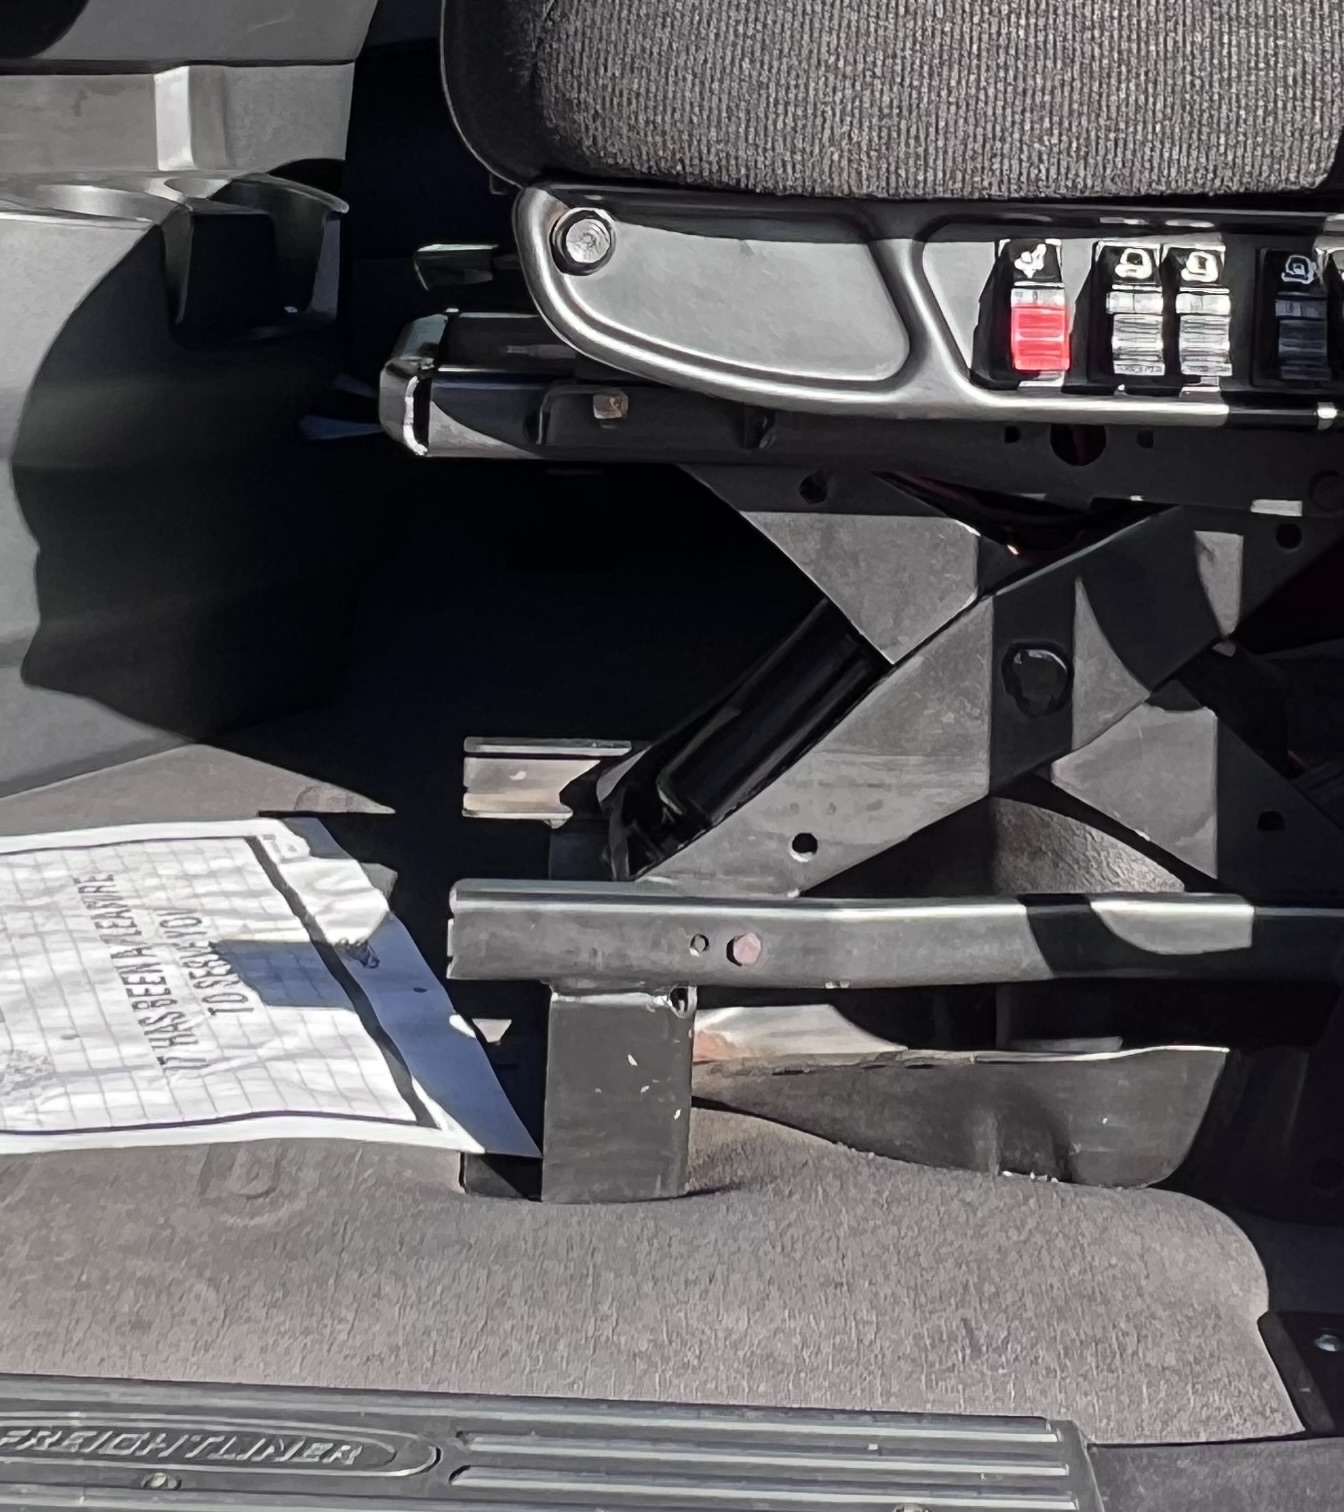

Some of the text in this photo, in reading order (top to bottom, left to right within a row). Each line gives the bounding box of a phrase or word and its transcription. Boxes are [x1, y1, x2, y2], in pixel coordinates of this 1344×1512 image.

[113, 962, 178, 1012] BEEN
[201, 991, 255, 1017] TO
[138, 1010, 199, 1051] HAS
